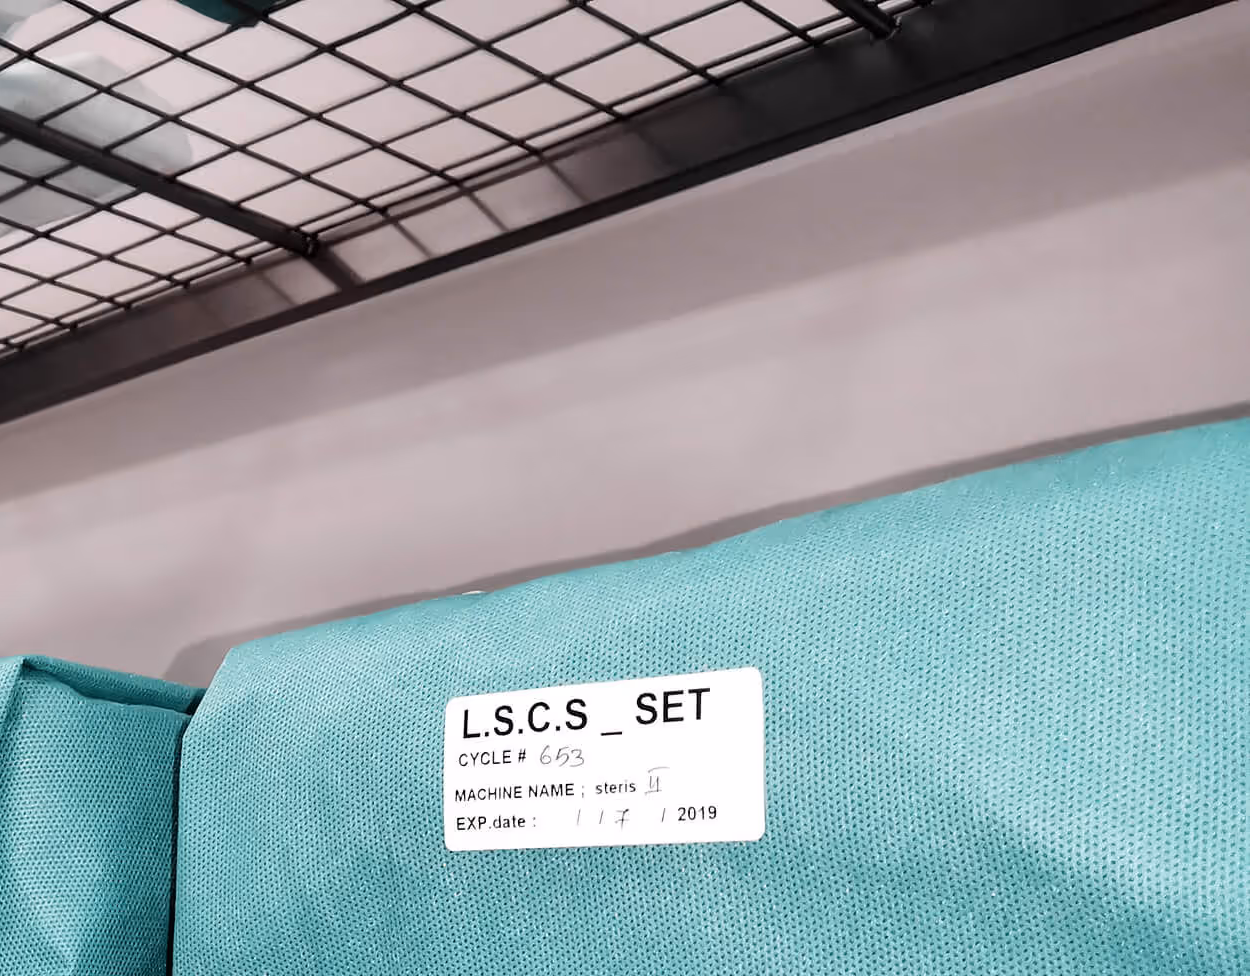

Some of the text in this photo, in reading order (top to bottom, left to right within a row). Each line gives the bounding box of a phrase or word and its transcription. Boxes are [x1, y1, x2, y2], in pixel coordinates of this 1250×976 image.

[462, 698, 588, 739] L.S.C.S
[635, 687, 711, 725] SET
[458, 745, 585, 767] CYCLE # 653
[455, 786, 522, 802] MACHINE
[528, 783, 574, 798] NAME
[595, 779, 636, 795] steris
[456, 815, 526, 831] EXP.date
[677, 805, 718, 822] 2019
